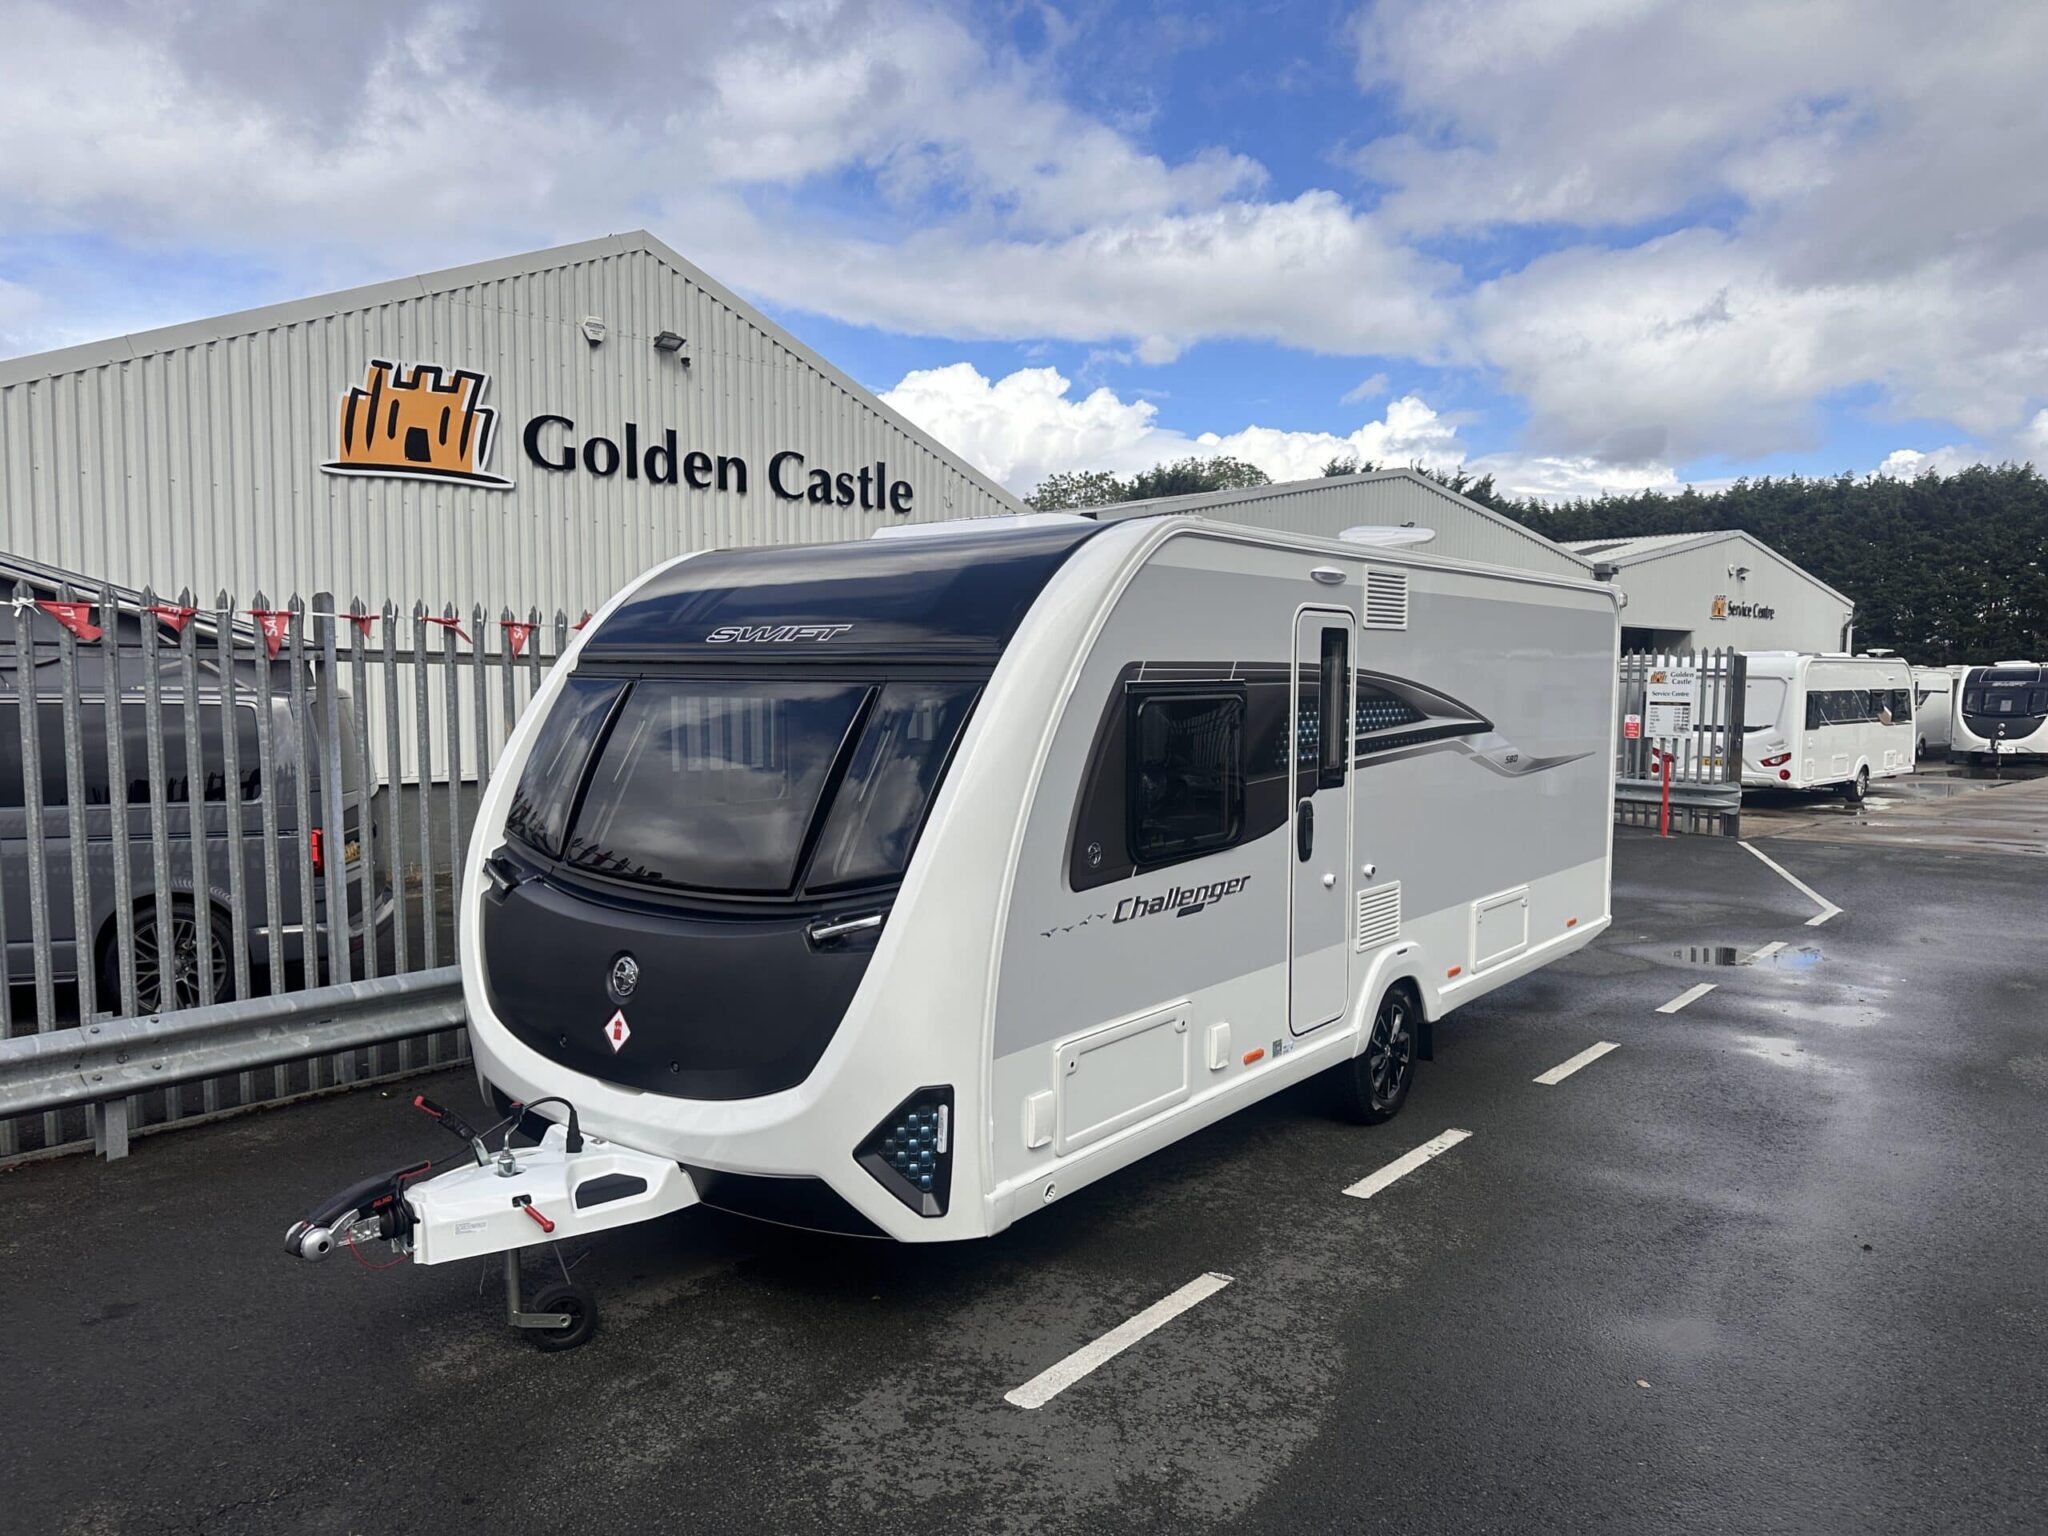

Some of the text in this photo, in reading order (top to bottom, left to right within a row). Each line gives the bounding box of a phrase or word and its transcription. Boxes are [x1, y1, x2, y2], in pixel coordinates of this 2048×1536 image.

[523, 414, 914, 513] Golden Castle
[1727, 600, 1775, 621] Service Centre
[705, 623, 855, 643] SWIFT
[1111, 875, 1252, 925] Challenger
